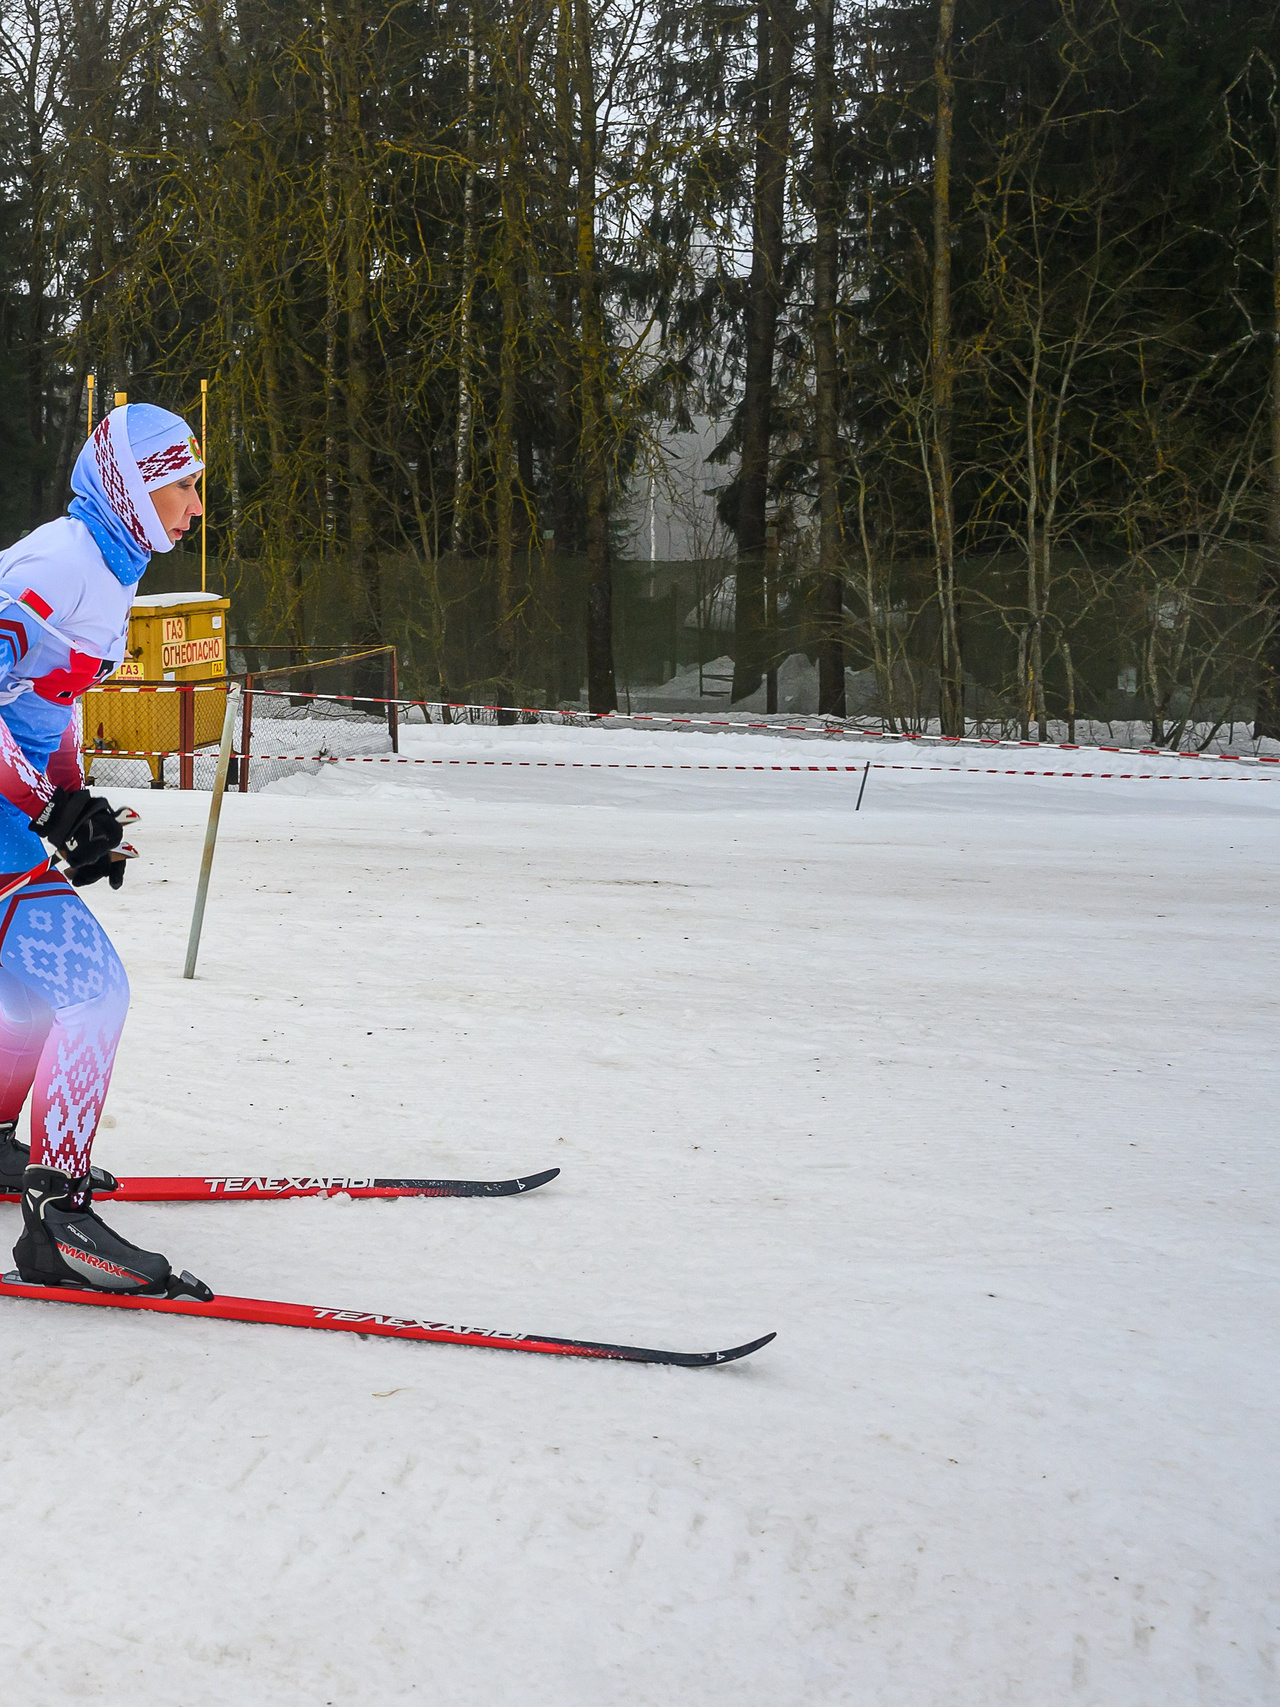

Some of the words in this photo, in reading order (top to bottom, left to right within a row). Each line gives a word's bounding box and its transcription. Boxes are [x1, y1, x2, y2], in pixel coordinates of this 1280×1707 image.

[166, 619, 184, 640] ГАЗ
[163, 638, 220, 667] ОГНЕОПАСНО
[120, 664, 139, 675] ГАЗ
[213, 662, 222, 673] ГАЗ
[60, 1243, 124, 1278] MARAX
